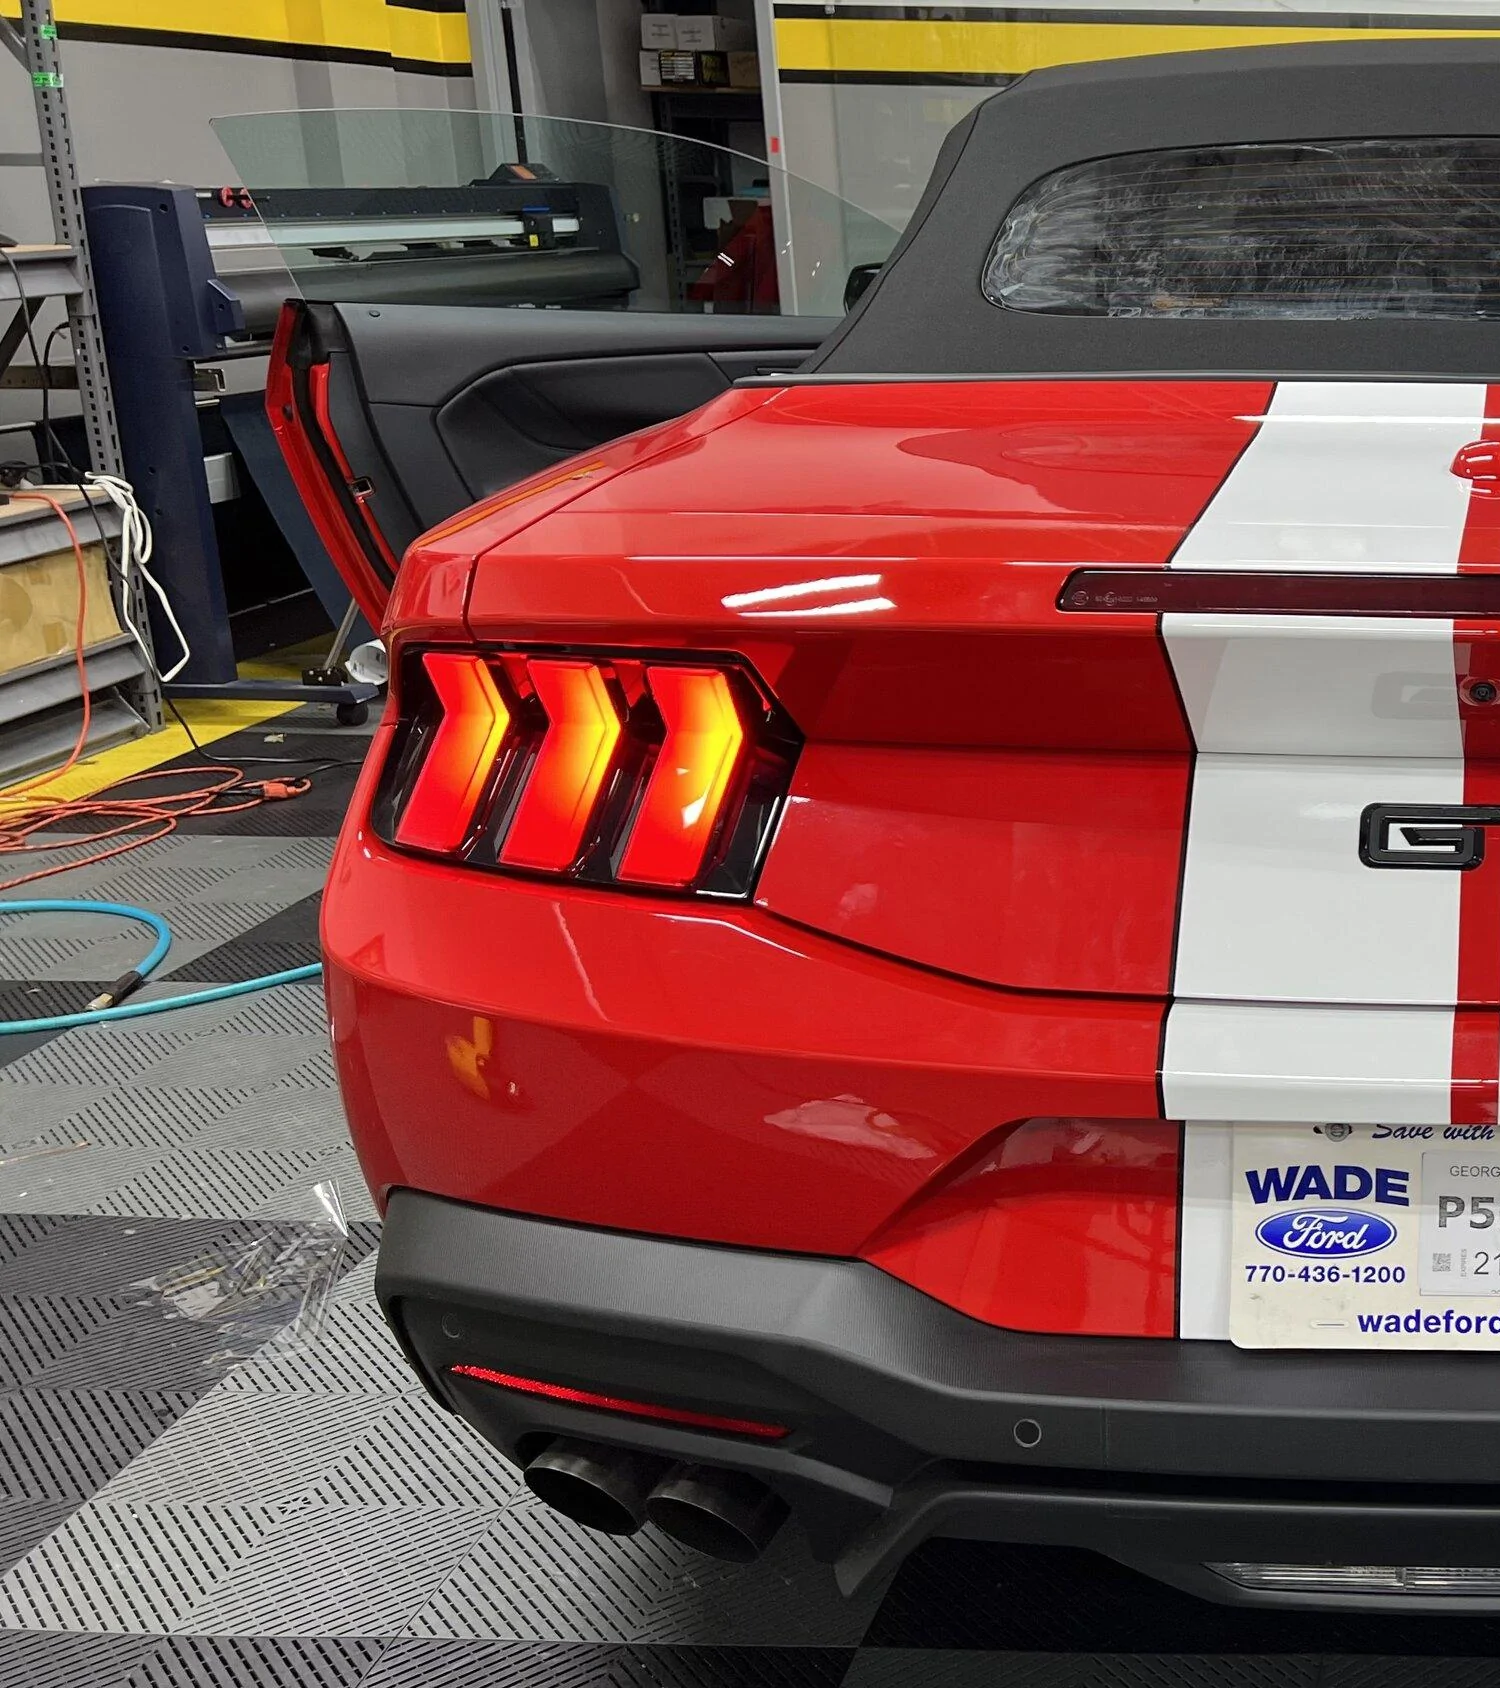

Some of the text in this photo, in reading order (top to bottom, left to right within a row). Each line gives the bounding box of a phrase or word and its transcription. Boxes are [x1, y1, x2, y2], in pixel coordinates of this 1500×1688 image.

[1371, 1123, 1434, 1140] Save
[1443, 1124, 1495, 1141] with
[1245, 1165, 1410, 1207] WADE
[1283, 1213, 1370, 1250] Ford
[1245, 1265, 1405, 1283] 770-436-1200
